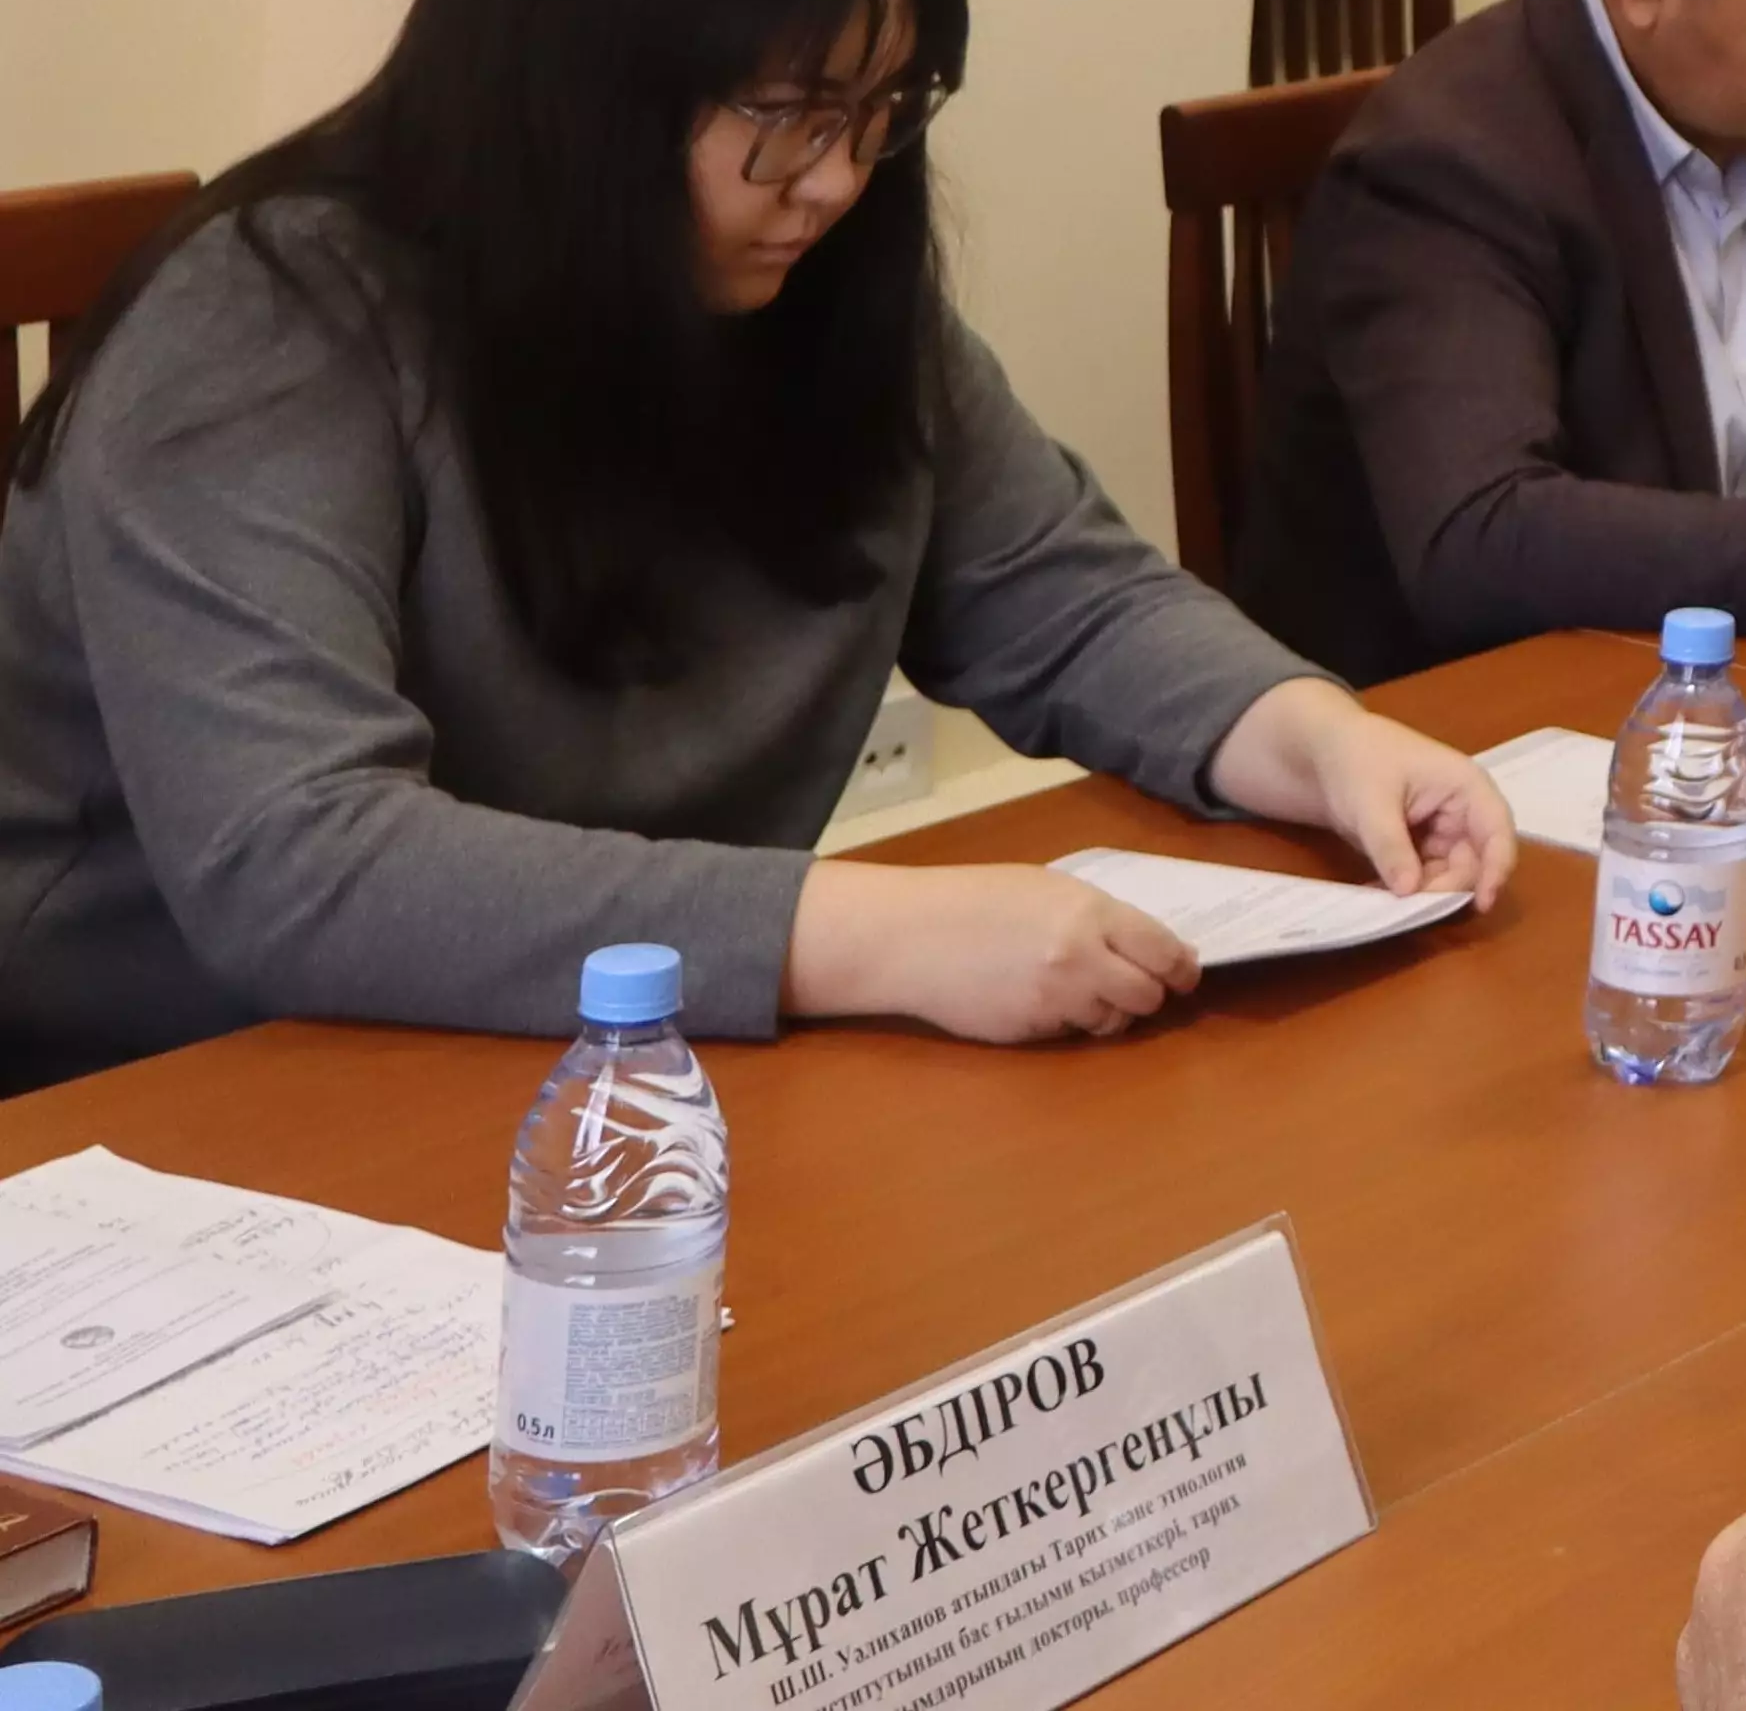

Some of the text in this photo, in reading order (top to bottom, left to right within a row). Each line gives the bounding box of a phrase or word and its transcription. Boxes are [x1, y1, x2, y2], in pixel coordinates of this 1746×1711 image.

[1610, 911, 1723, 951] TASSAY
[849, 1336, 1106, 1496] ӘБДІРОВ
[701, 1371, 1269, 1680] Мұрат Жеткергенұлы
[770, 1452, 1248, 1706] Ш.Ш. Уәлиханов атындағы Тарих және этнология
[958, 1623, 992, 1651] бас
[995, 1579, 1076, 1634] ғылыми
[1190, 1493, 1242, 1531] тарих
[1117, 1546, 1212, 1607] профессор
